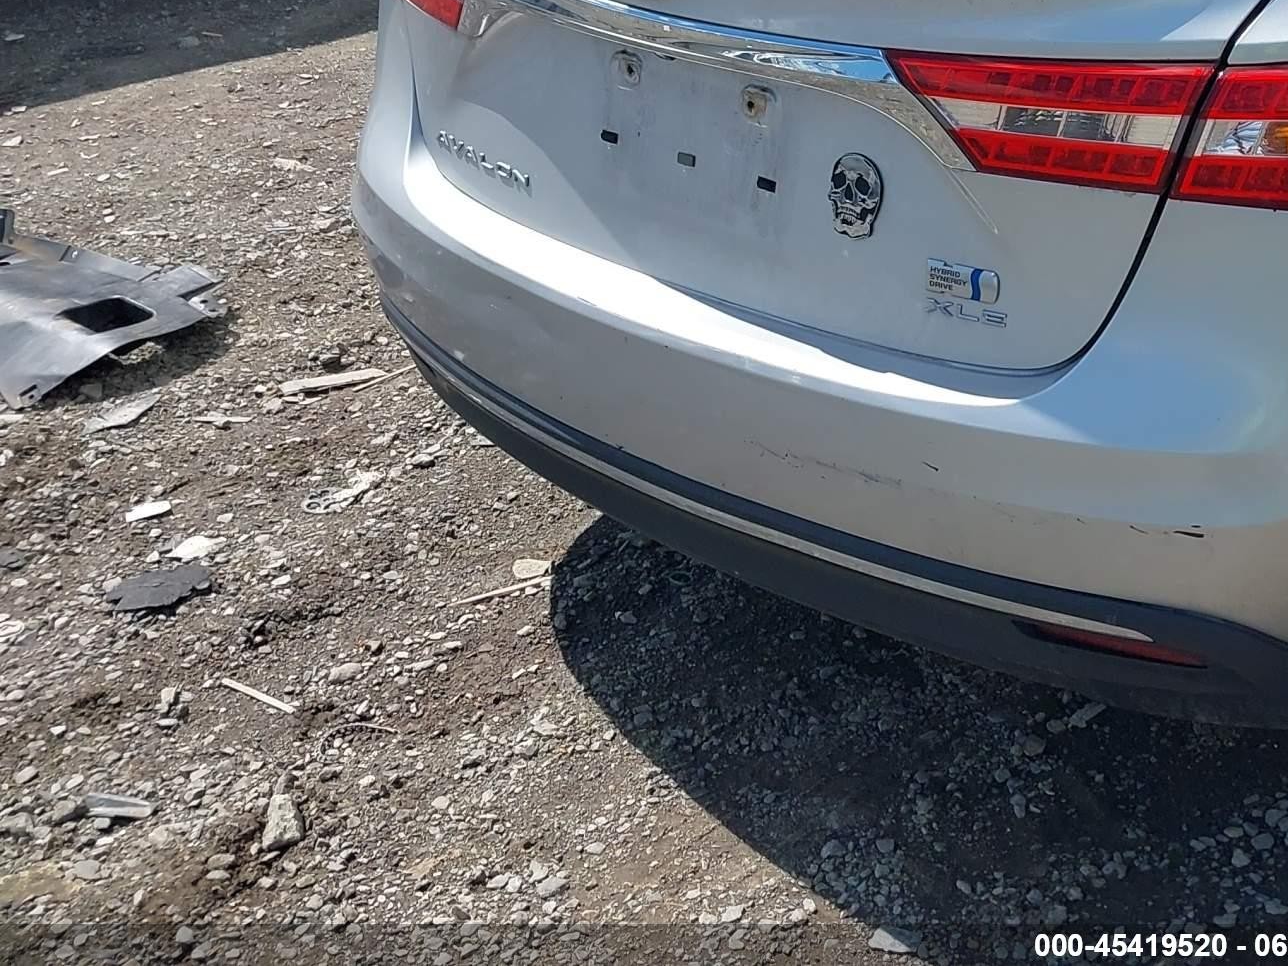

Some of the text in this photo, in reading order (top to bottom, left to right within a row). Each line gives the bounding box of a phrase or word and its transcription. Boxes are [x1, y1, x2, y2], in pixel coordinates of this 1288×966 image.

[437, 130, 531, 193] AVALON
[930, 266, 961, 278] HYBRID
[929, 274, 968, 287] SYNERGY
[929, 280, 954, 291] DRIVE
[926, 297, 1008, 328] XLE
